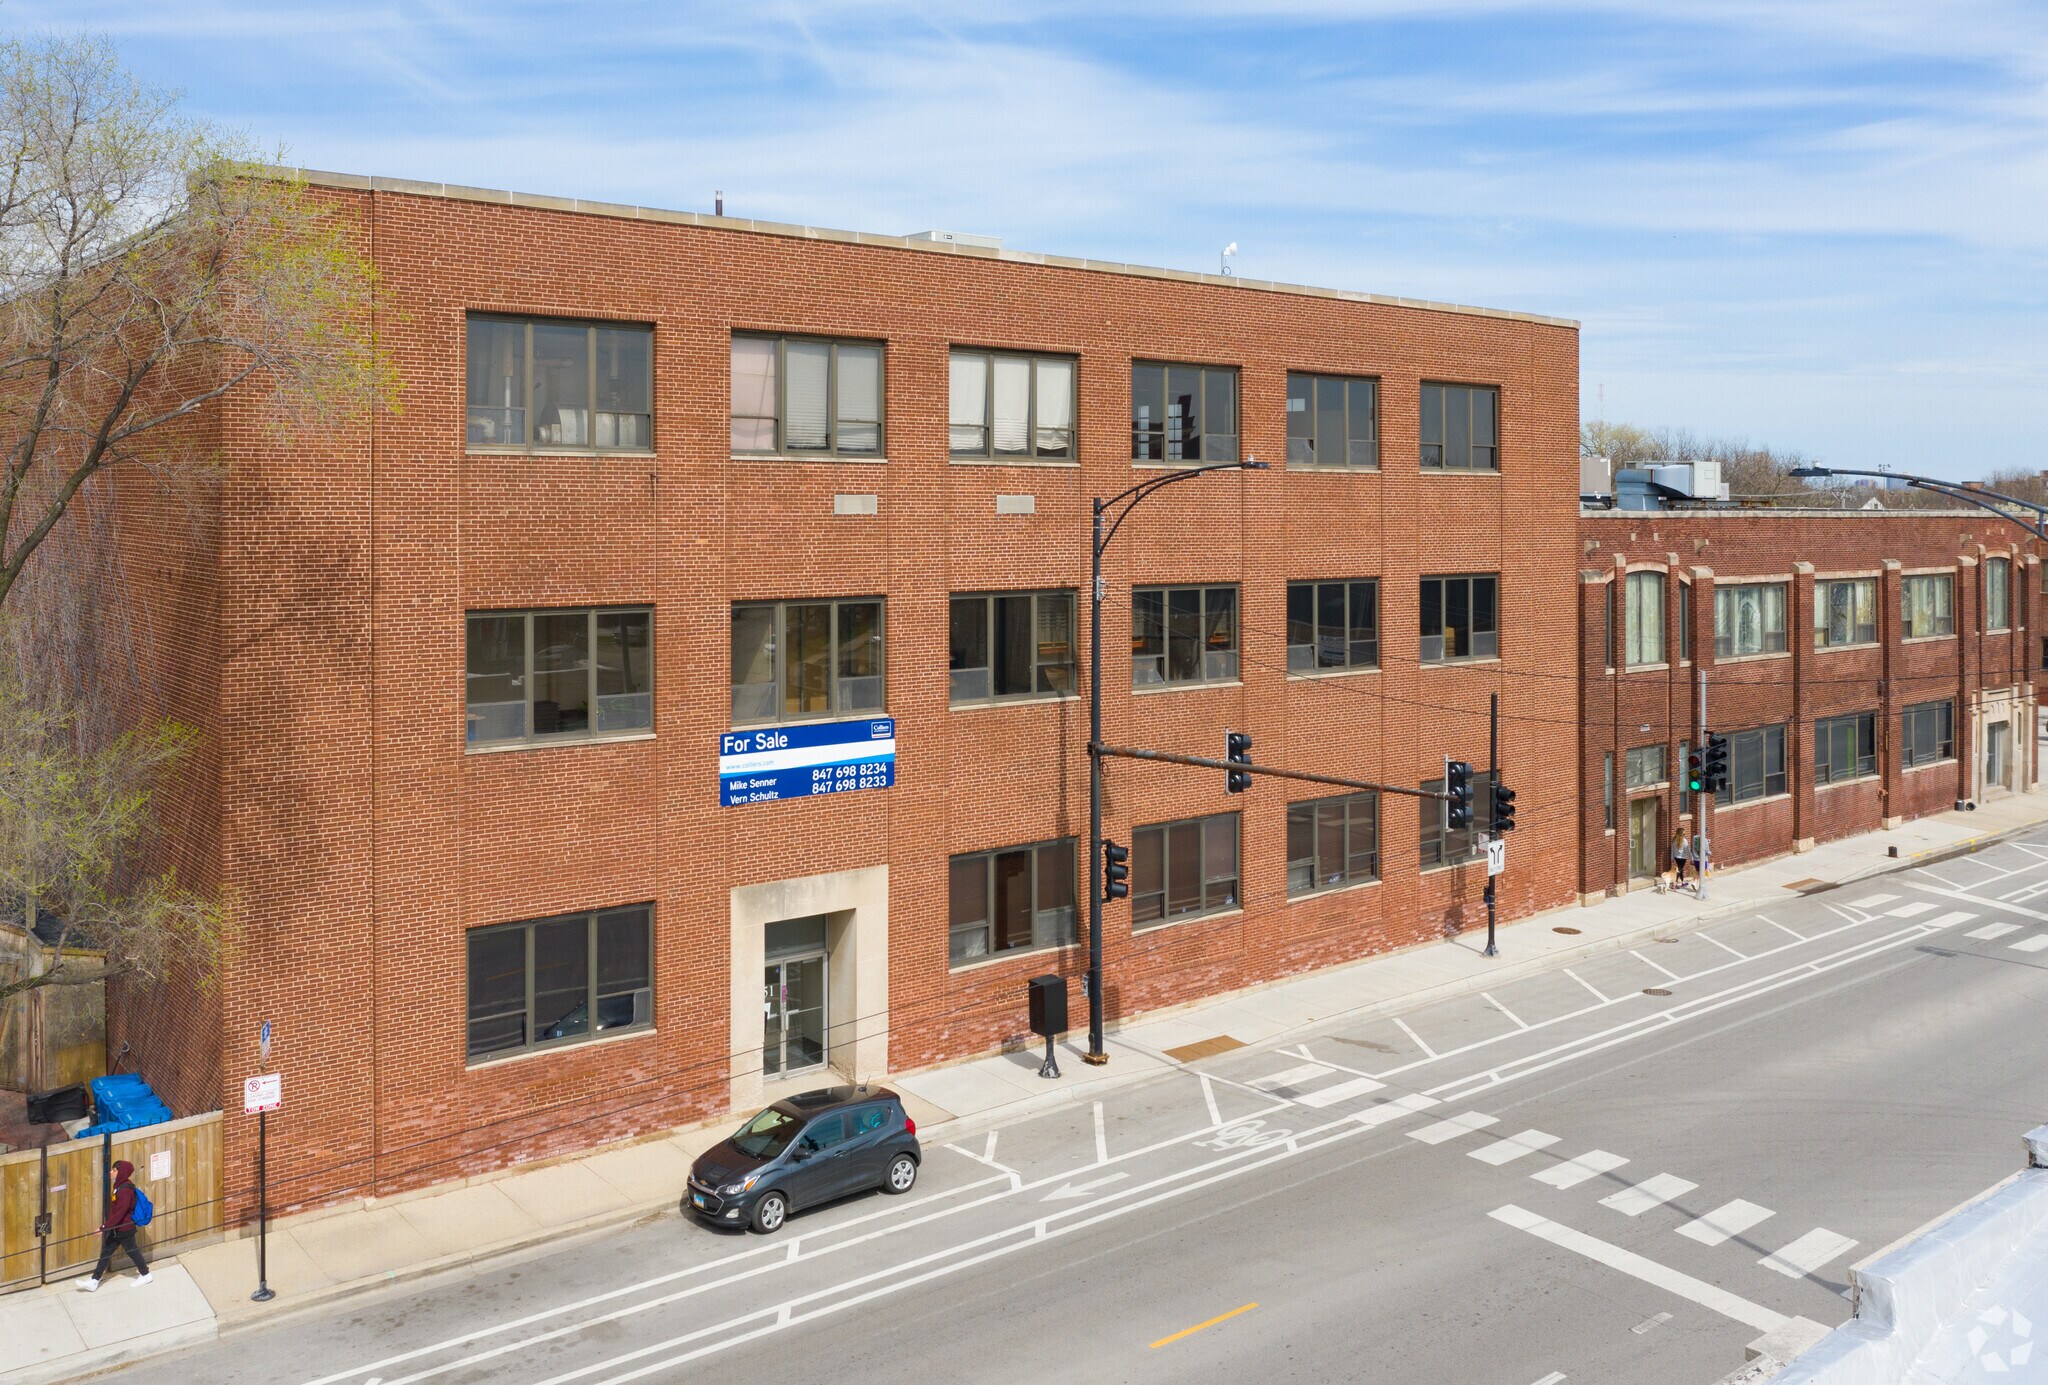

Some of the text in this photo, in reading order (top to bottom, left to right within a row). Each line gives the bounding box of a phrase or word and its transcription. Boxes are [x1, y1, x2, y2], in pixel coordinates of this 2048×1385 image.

[724, 731, 788, 753] For Sale
[725, 760, 774, 770] www.colliers.com
[812, 762, 887, 781] 847 698 8234
[729, 778, 777, 790] Mike Senner
[812, 775, 887, 794] 847 698 8233
[730, 790, 779, 804] Vern Schultz
